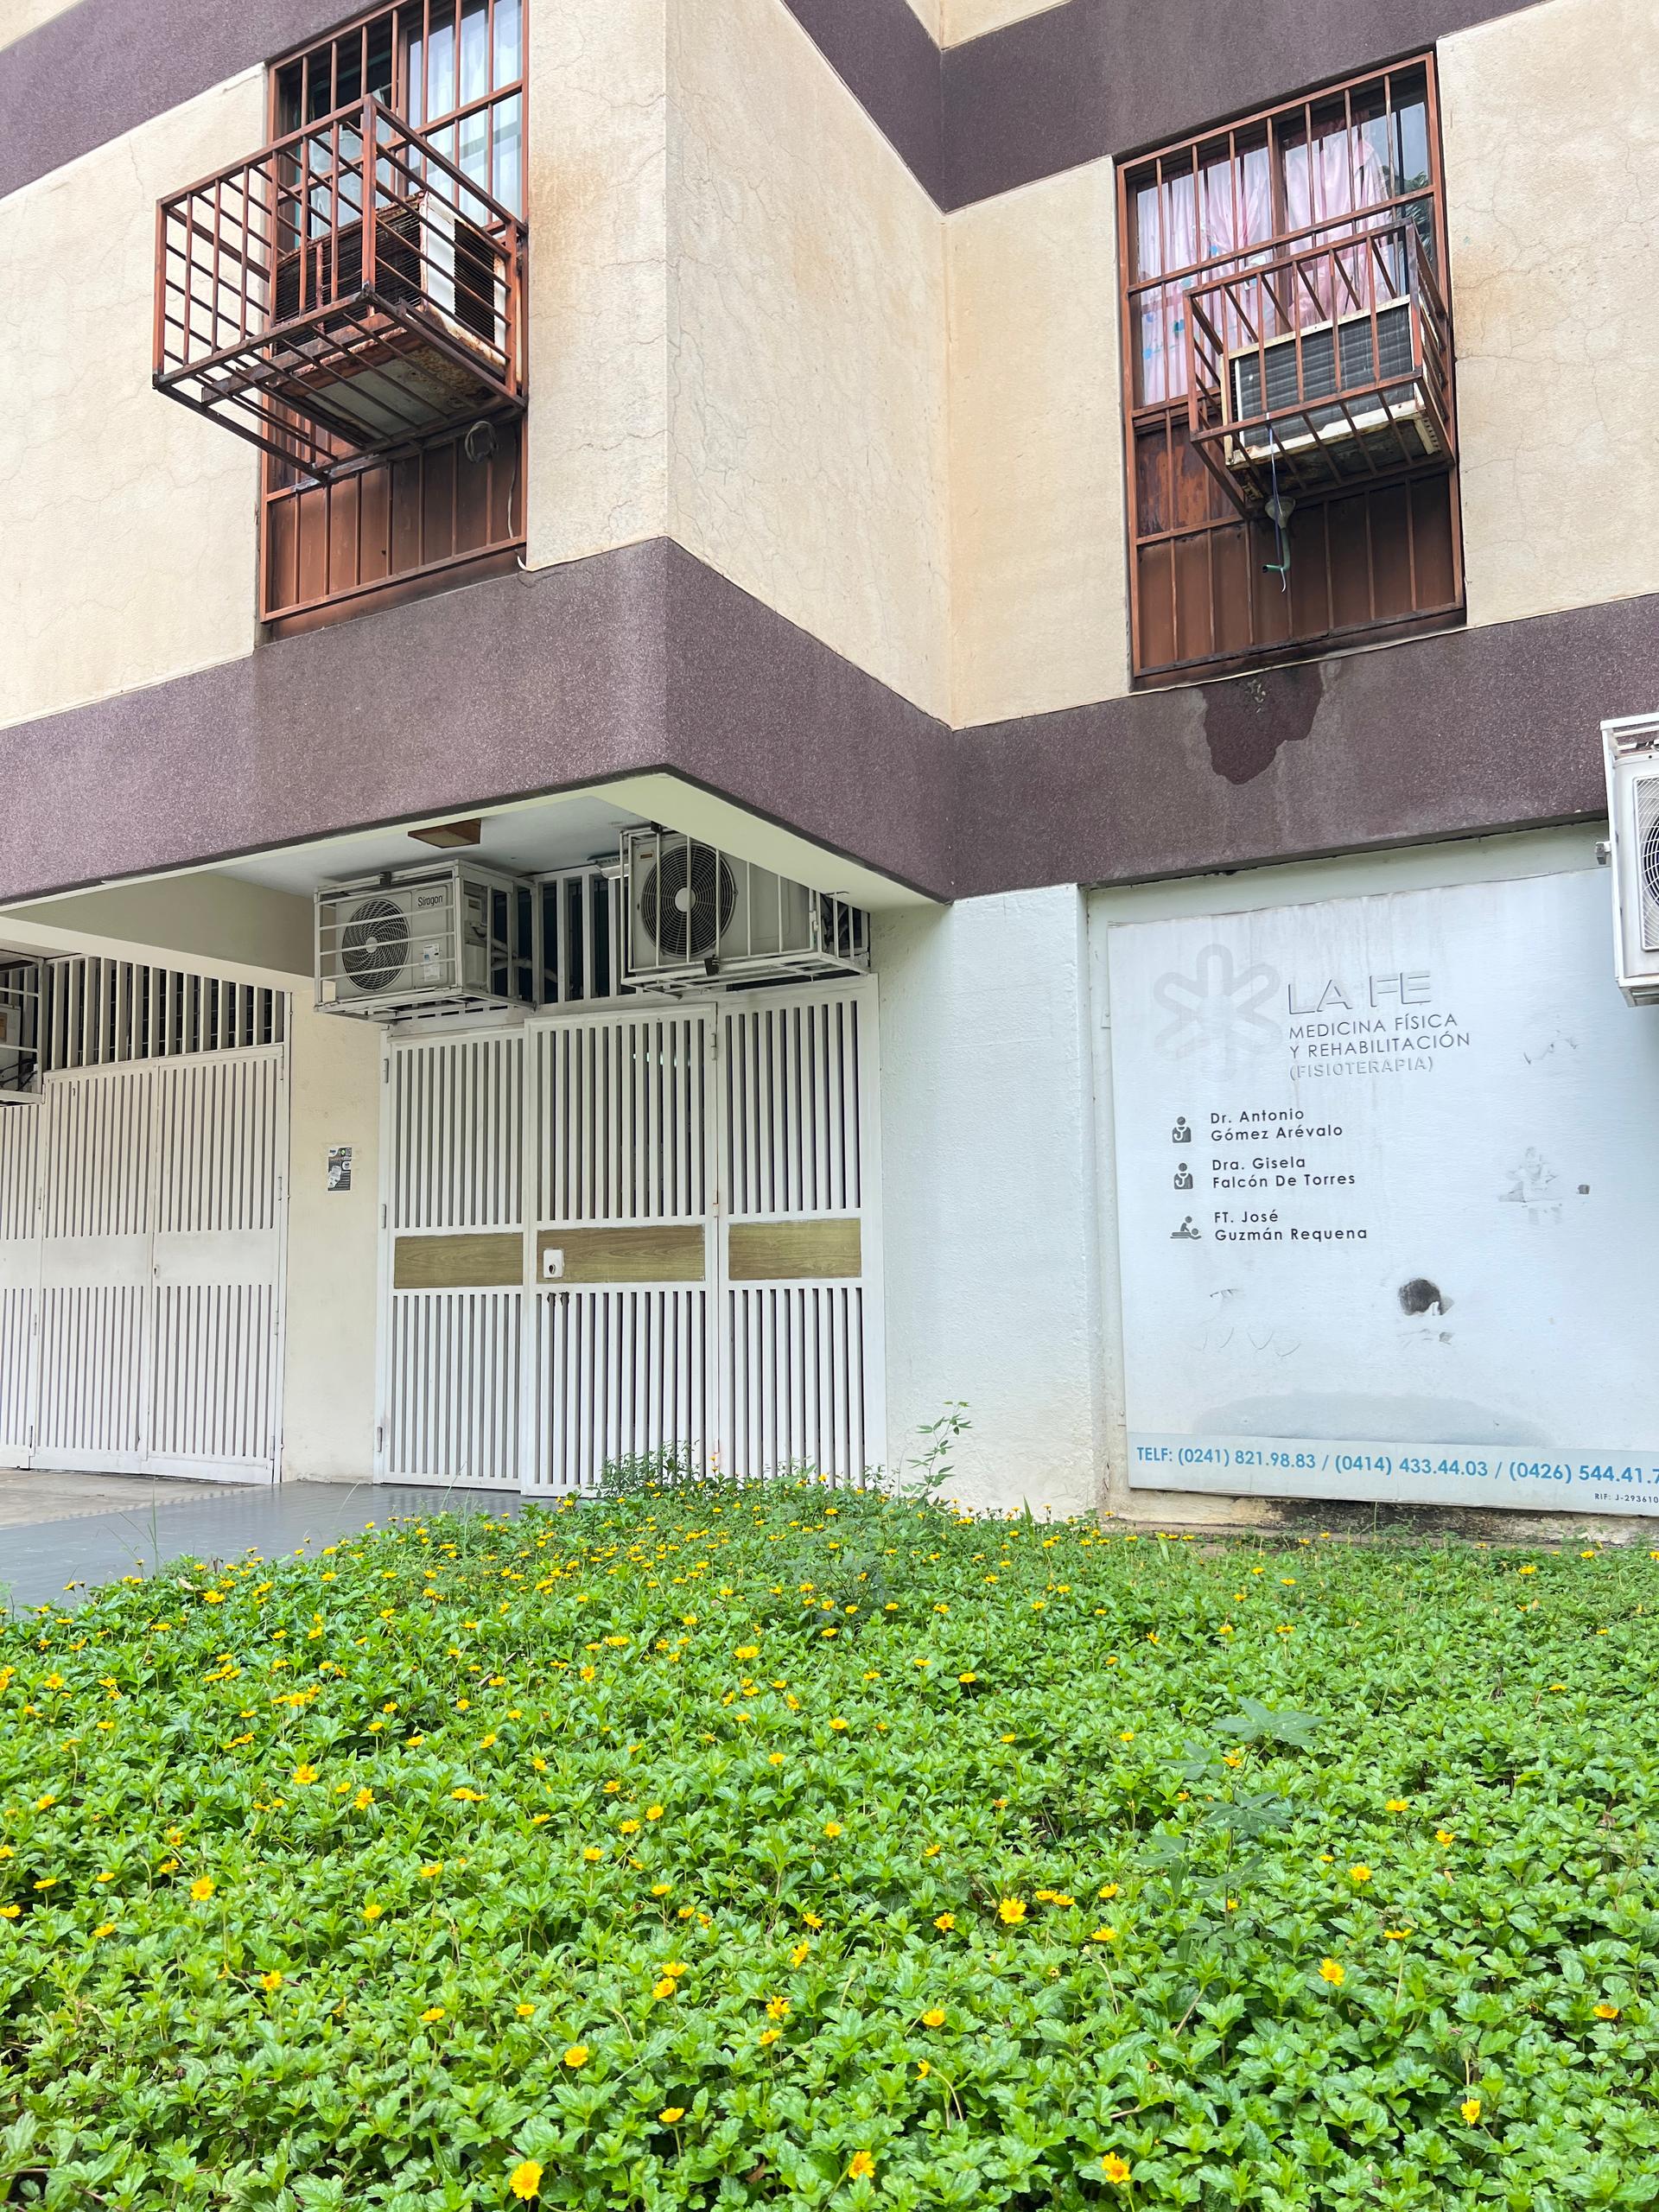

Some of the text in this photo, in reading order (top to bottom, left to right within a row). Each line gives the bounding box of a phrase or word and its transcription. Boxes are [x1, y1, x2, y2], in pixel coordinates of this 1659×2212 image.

[1288, 971, 1431, 1014] LA FE
[1289, 1014, 1457, 1039] MEDICINA FÍSICA
[1290, 1031, 1470, 1058] Y REHABILITACIÓN
[1289, 1056, 1433, 1081] (FISIOTERAPIA)
[1211, 1109, 1304, 1124] Dr. Antonio
[1211, 1124, 1343, 1141] Gómez Arévalo
[1212, 1156, 1306, 1170] Dra. Gisela
[1213, 1174, 1355, 1188] Falcón De Torres
[1214, 1210, 1279, 1223] FT. José
[1215, 1228, 1367, 1242] Guzmán Requena
[1137, 1447, 1173, 1461] TELF:
[1178, 1448, 1230, 1466] (0241)
[1235, 1451, 1315, 1468] 821.98.83
[1322, 1454, 1329, 1471] /
[1335, 1455, 1391, 1475] (0414)
[1400, 1458, 1488, 1476] 433.44.03
[1495, 1462, 1503, 1479] /
[1510, 1462, 1572, 1484] (0426)
